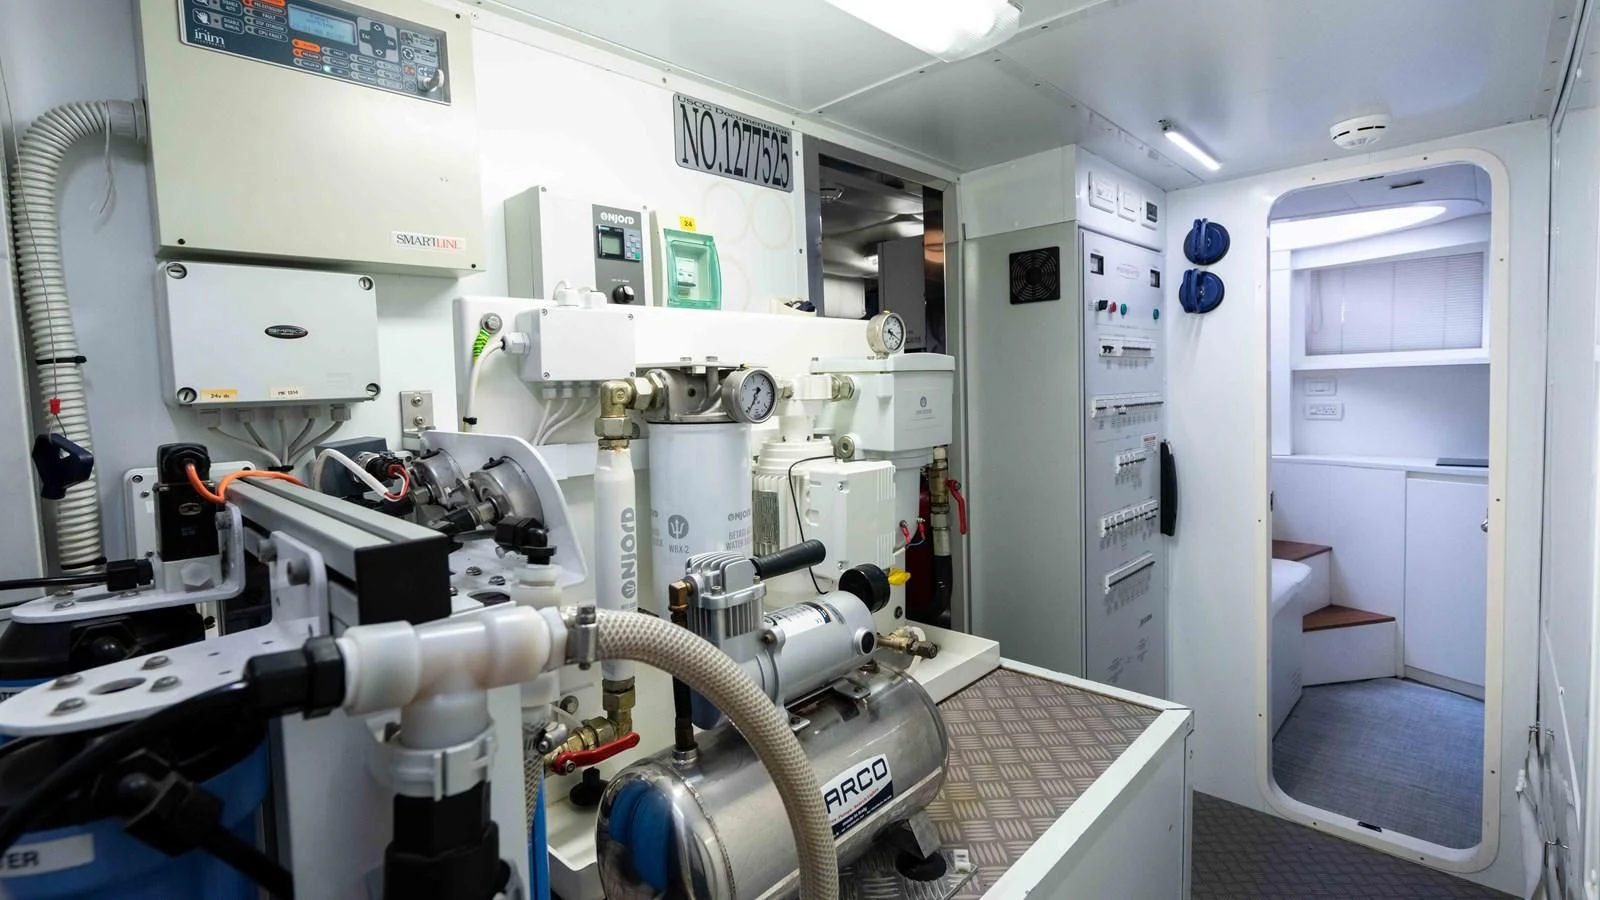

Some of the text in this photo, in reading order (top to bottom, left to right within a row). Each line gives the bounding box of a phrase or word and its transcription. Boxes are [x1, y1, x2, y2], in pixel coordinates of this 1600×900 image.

[194, 27, 225, 45] inim
[677, 95, 790, 136] USCG Documentation
[680, 103, 790, 188] NO.1277525
